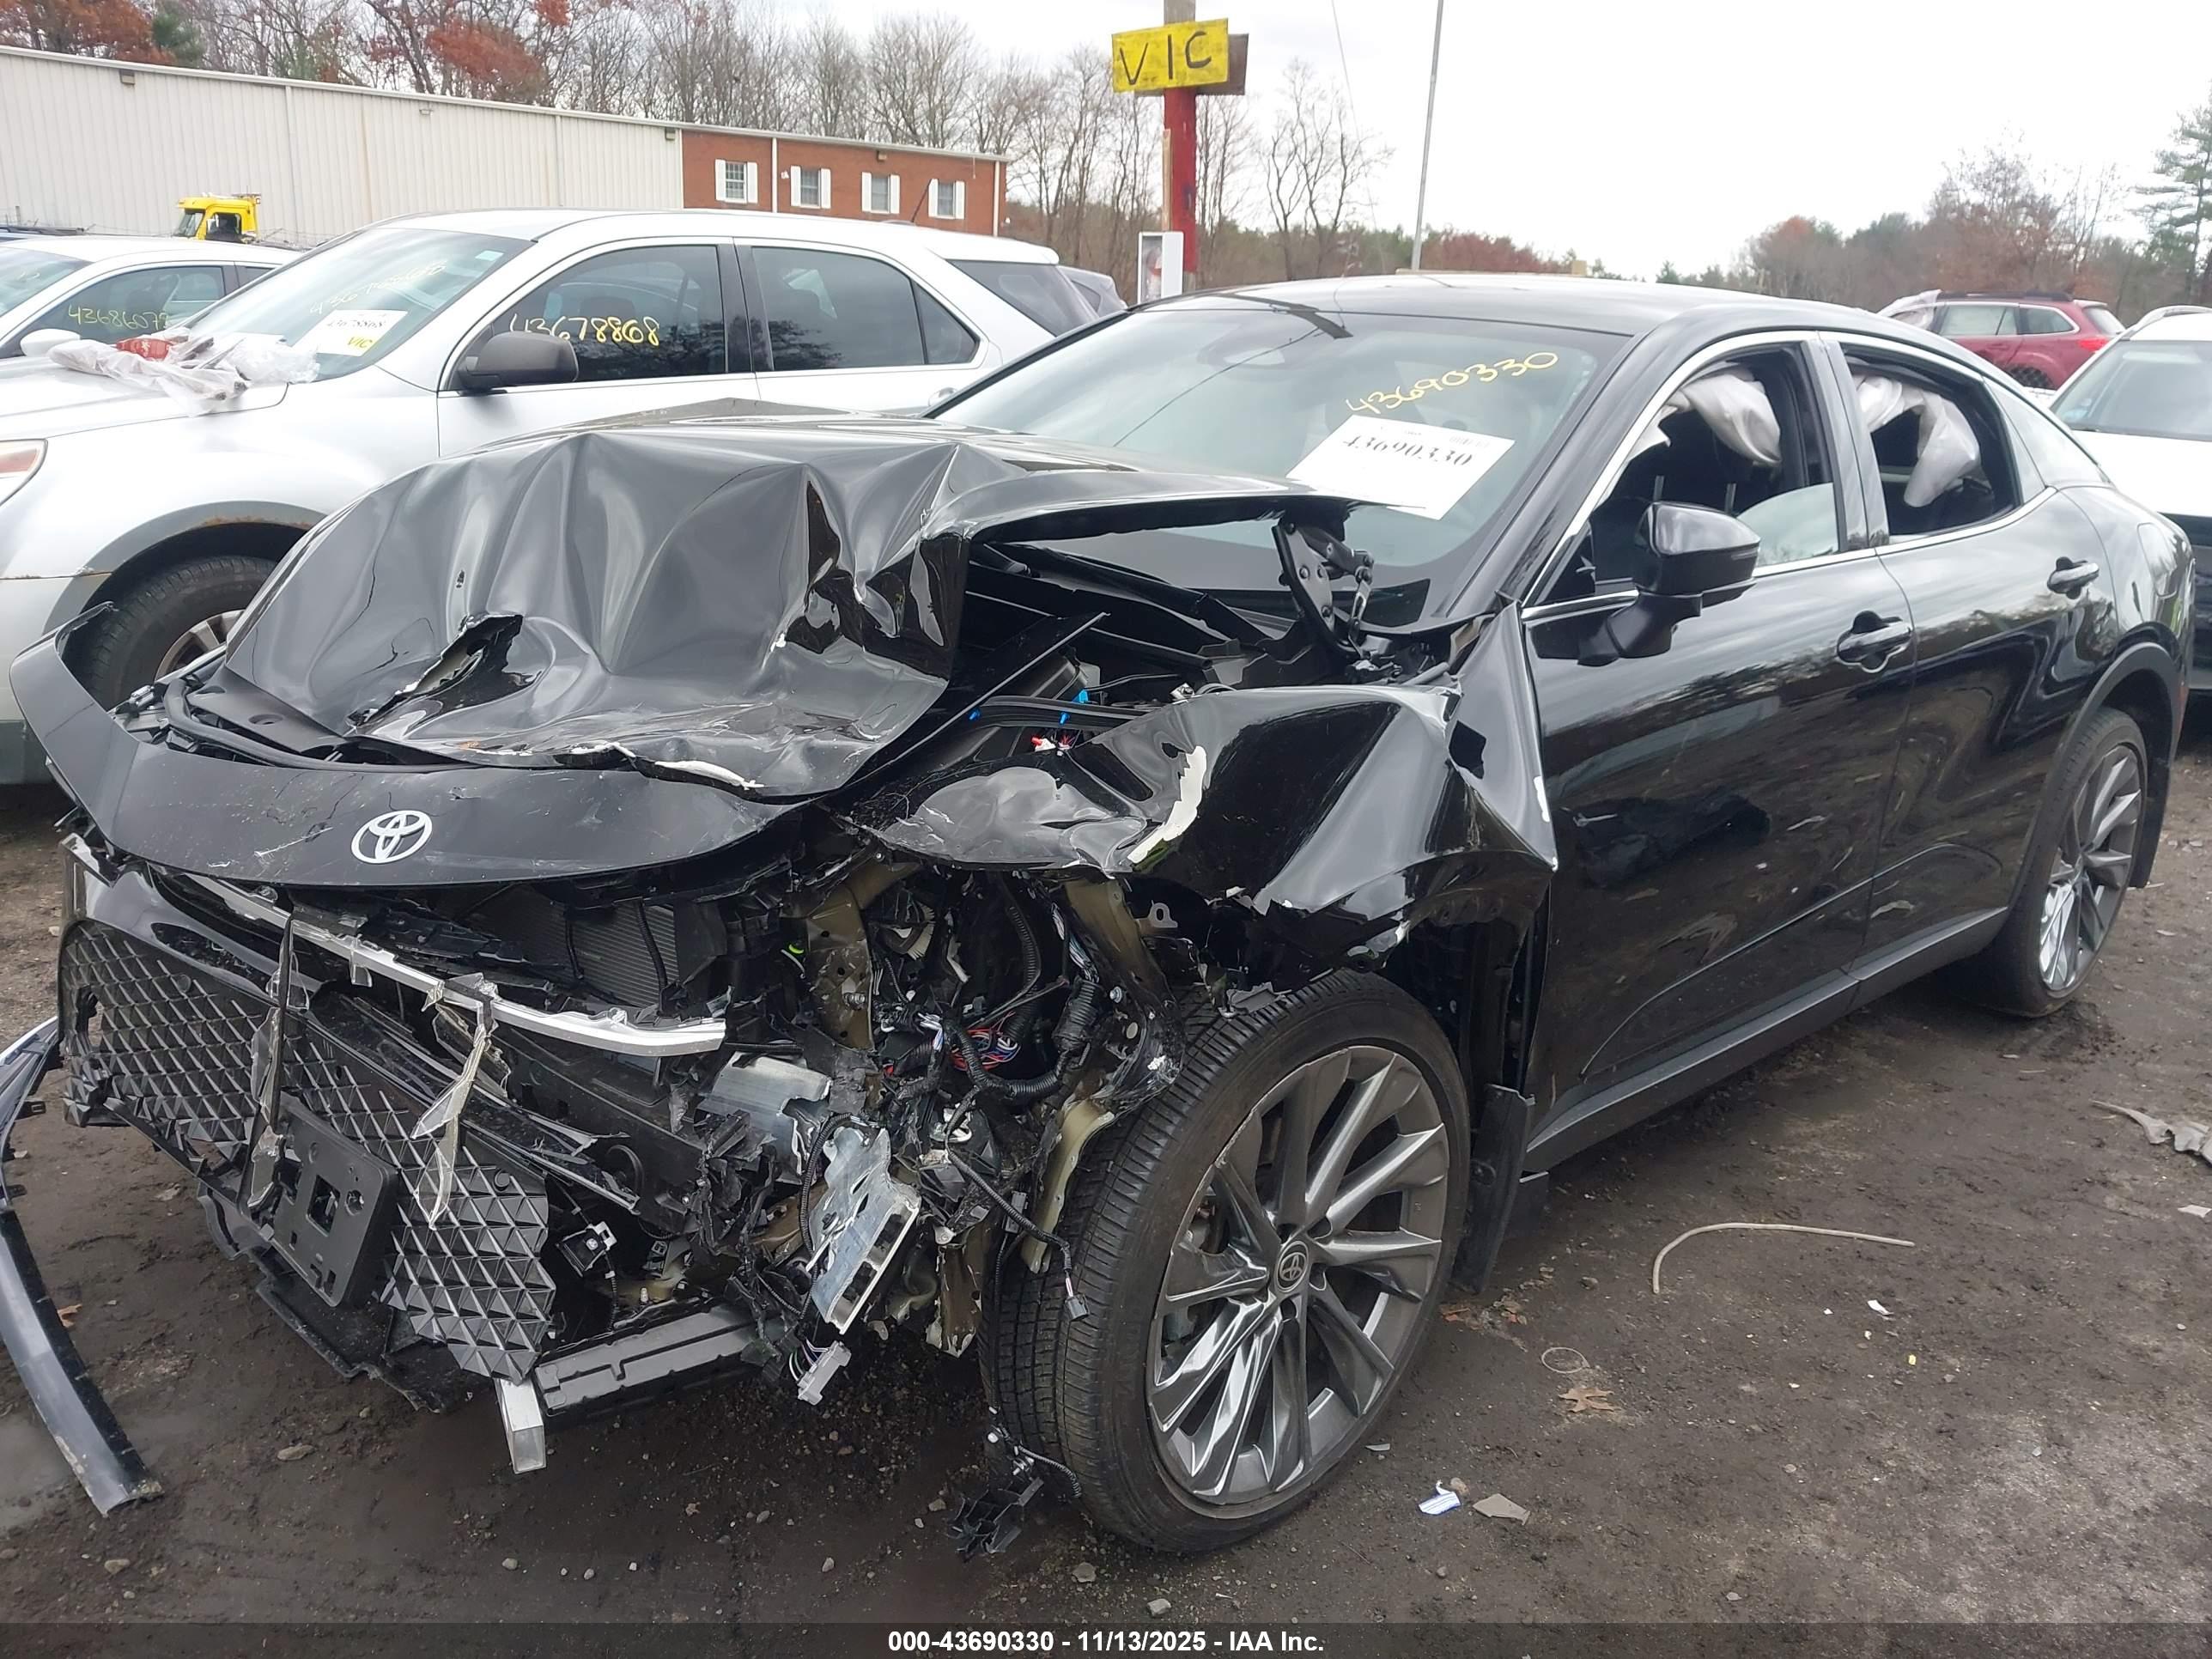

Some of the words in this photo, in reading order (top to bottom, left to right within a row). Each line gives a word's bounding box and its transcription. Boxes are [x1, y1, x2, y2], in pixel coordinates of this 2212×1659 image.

[1119, 30, 1212, 85] VIC
[347, 337, 373, 349] VIC
[1345, 352, 1559, 414] 43690330
[1342, 434, 1474, 466] 43690330
